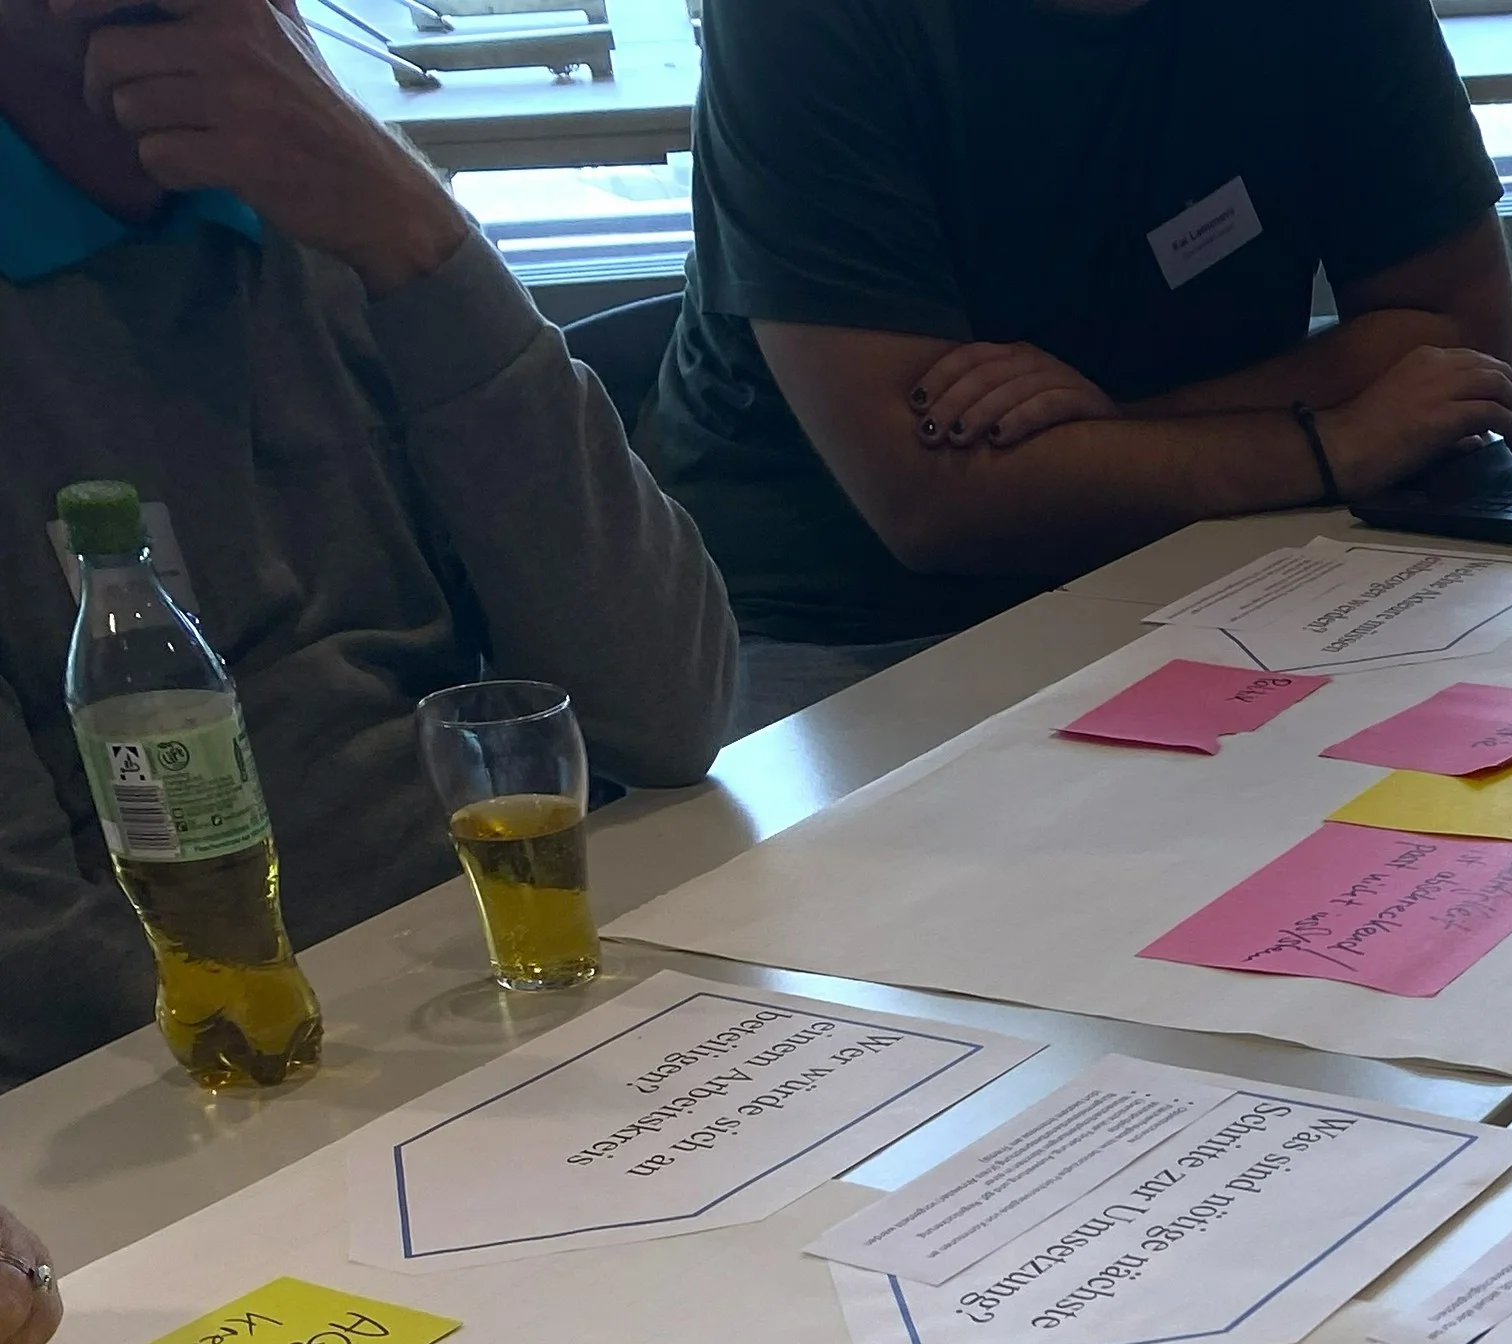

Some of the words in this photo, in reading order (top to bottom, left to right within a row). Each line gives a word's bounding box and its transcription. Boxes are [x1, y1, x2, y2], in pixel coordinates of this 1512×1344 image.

[1303, 600, 1369, 633] werden?
[1330, 874, 1390, 906] nicht
[627, 1011, 792, 1093] beteiligen?
[744, 1022, 835, 1066] einem
[830, 1036, 903, 1065] Wer
[738, 1069, 834, 1115] würde
[567, 1068, 753, 1165] Arbeitskreis
[670, 1117, 740, 1151] sich
[1178, 1103, 1291, 1167] Schritte
[1283, 1119, 1357, 1151] Was
[627, 1155, 675, 1175] an
[1131, 1170, 1185, 1201] zur
[1225, 1154, 1290, 1193] sind
[1141, 1194, 1235, 1251] nötige
[956, 1205, 1149, 1323] Umsetzung?
[1031, 1254, 1148, 1328] nächste
